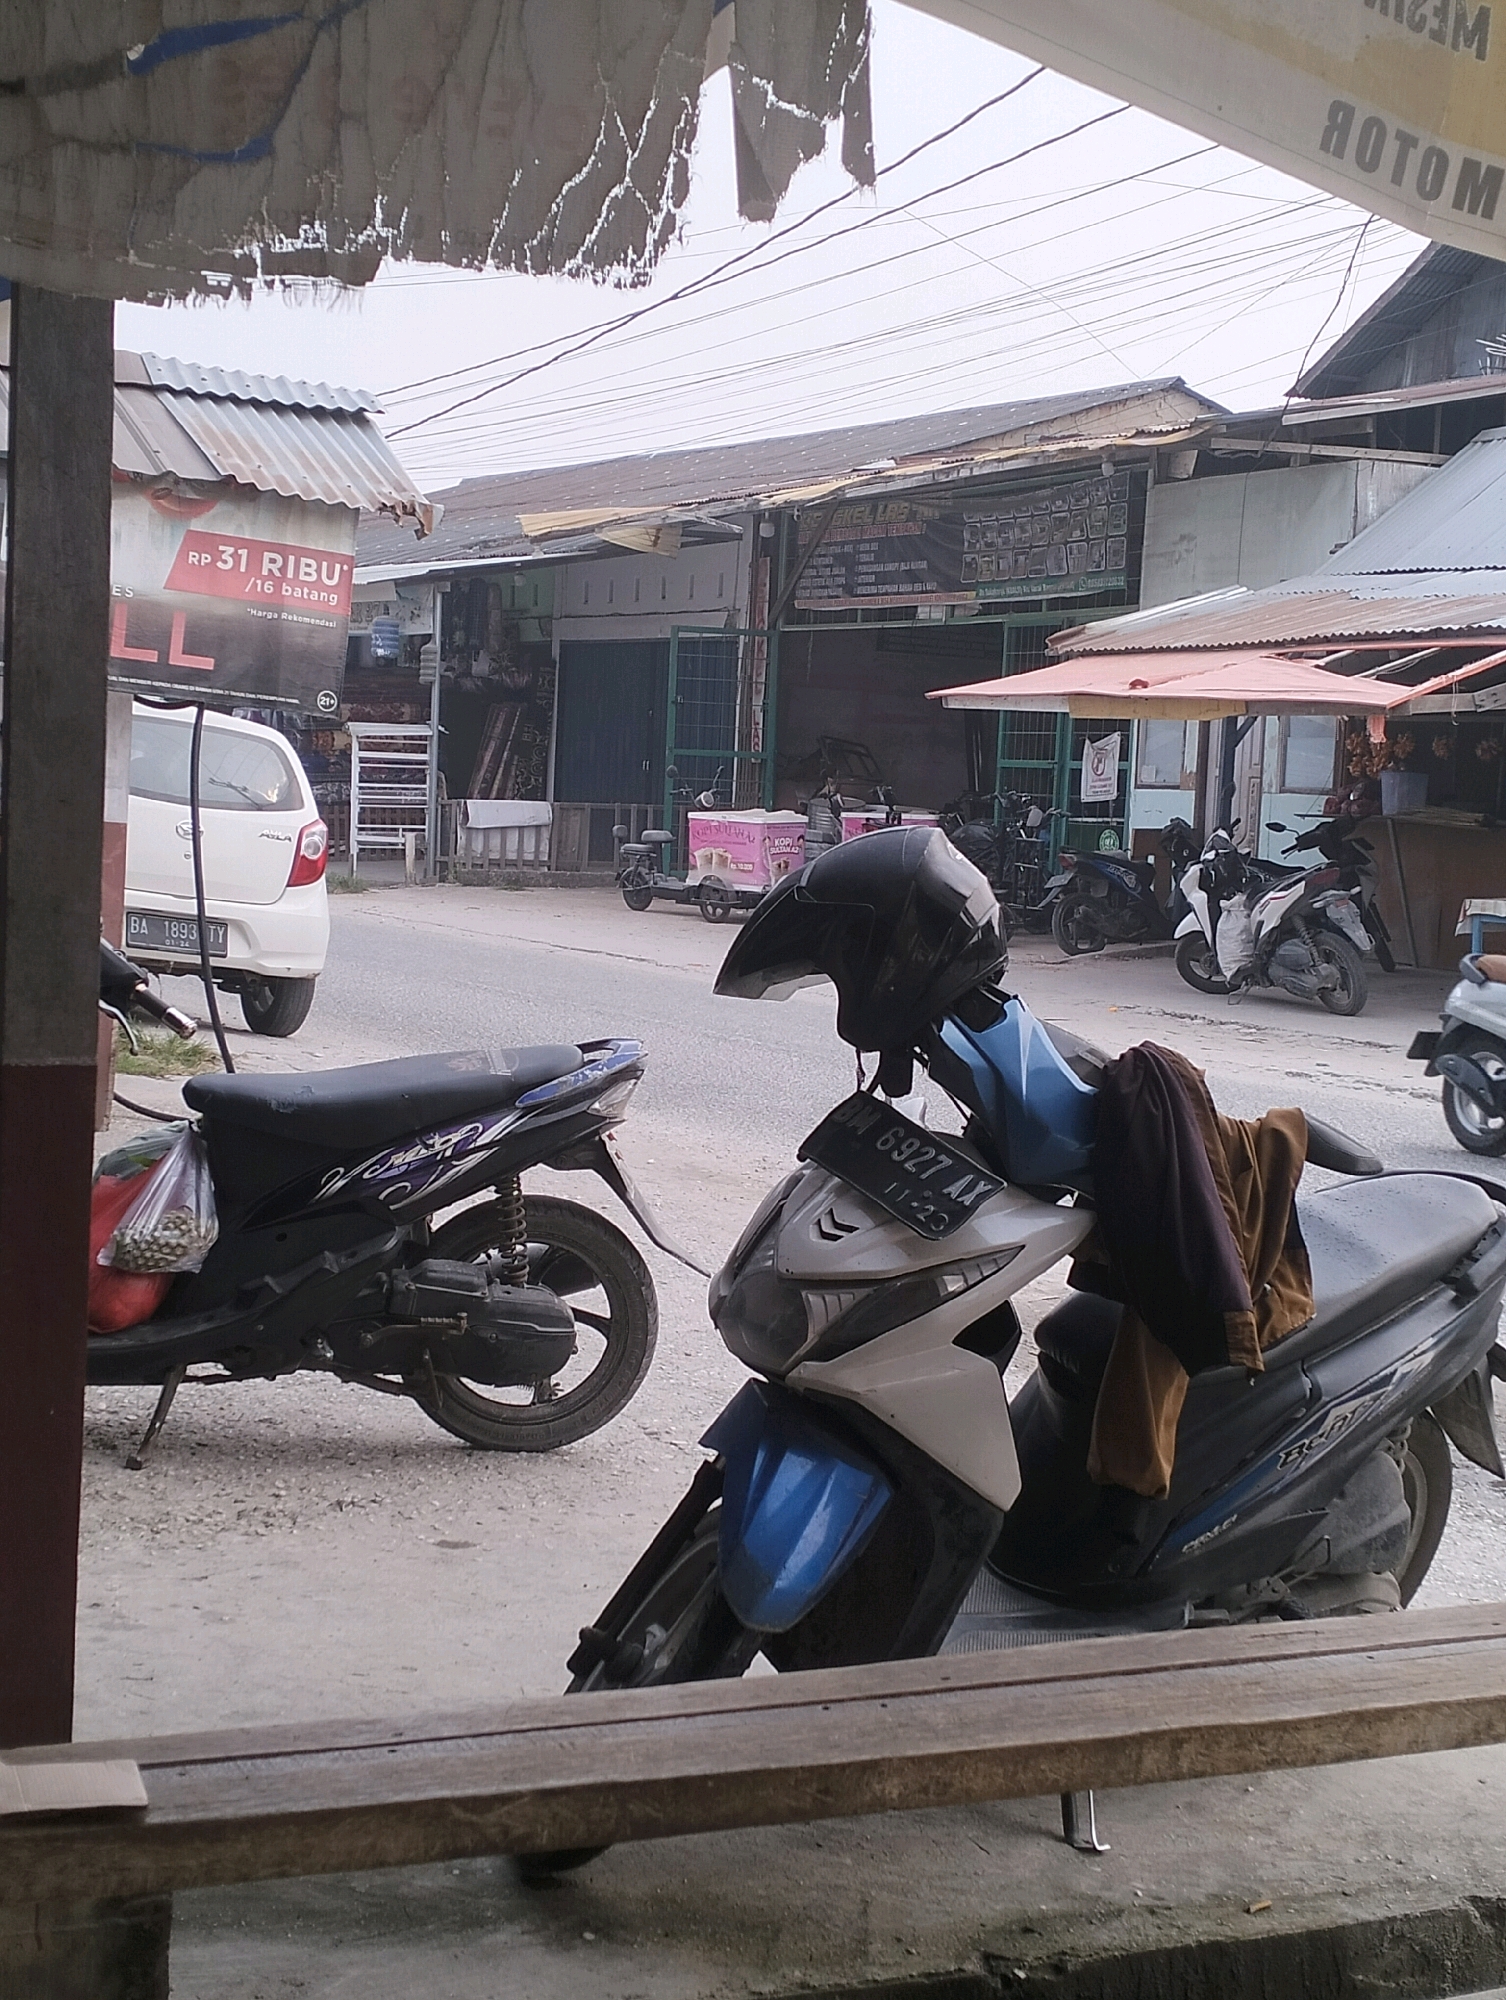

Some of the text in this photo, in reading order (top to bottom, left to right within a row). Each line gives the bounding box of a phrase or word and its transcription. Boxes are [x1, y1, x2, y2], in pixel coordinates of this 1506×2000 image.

[188, 551, 211, 566] RP
[216, 545, 248, 573] 31
[245, 577, 339, 606] /16 batang
[281, 612, 337, 628] Rekomendasi
[110, 602, 215, 670] LL
[774, 837, 793, 847] KOPI
[130, 916, 225, 944] BA 1893 TY
[831, 1100, 994, 1208] BM 6927 AX
